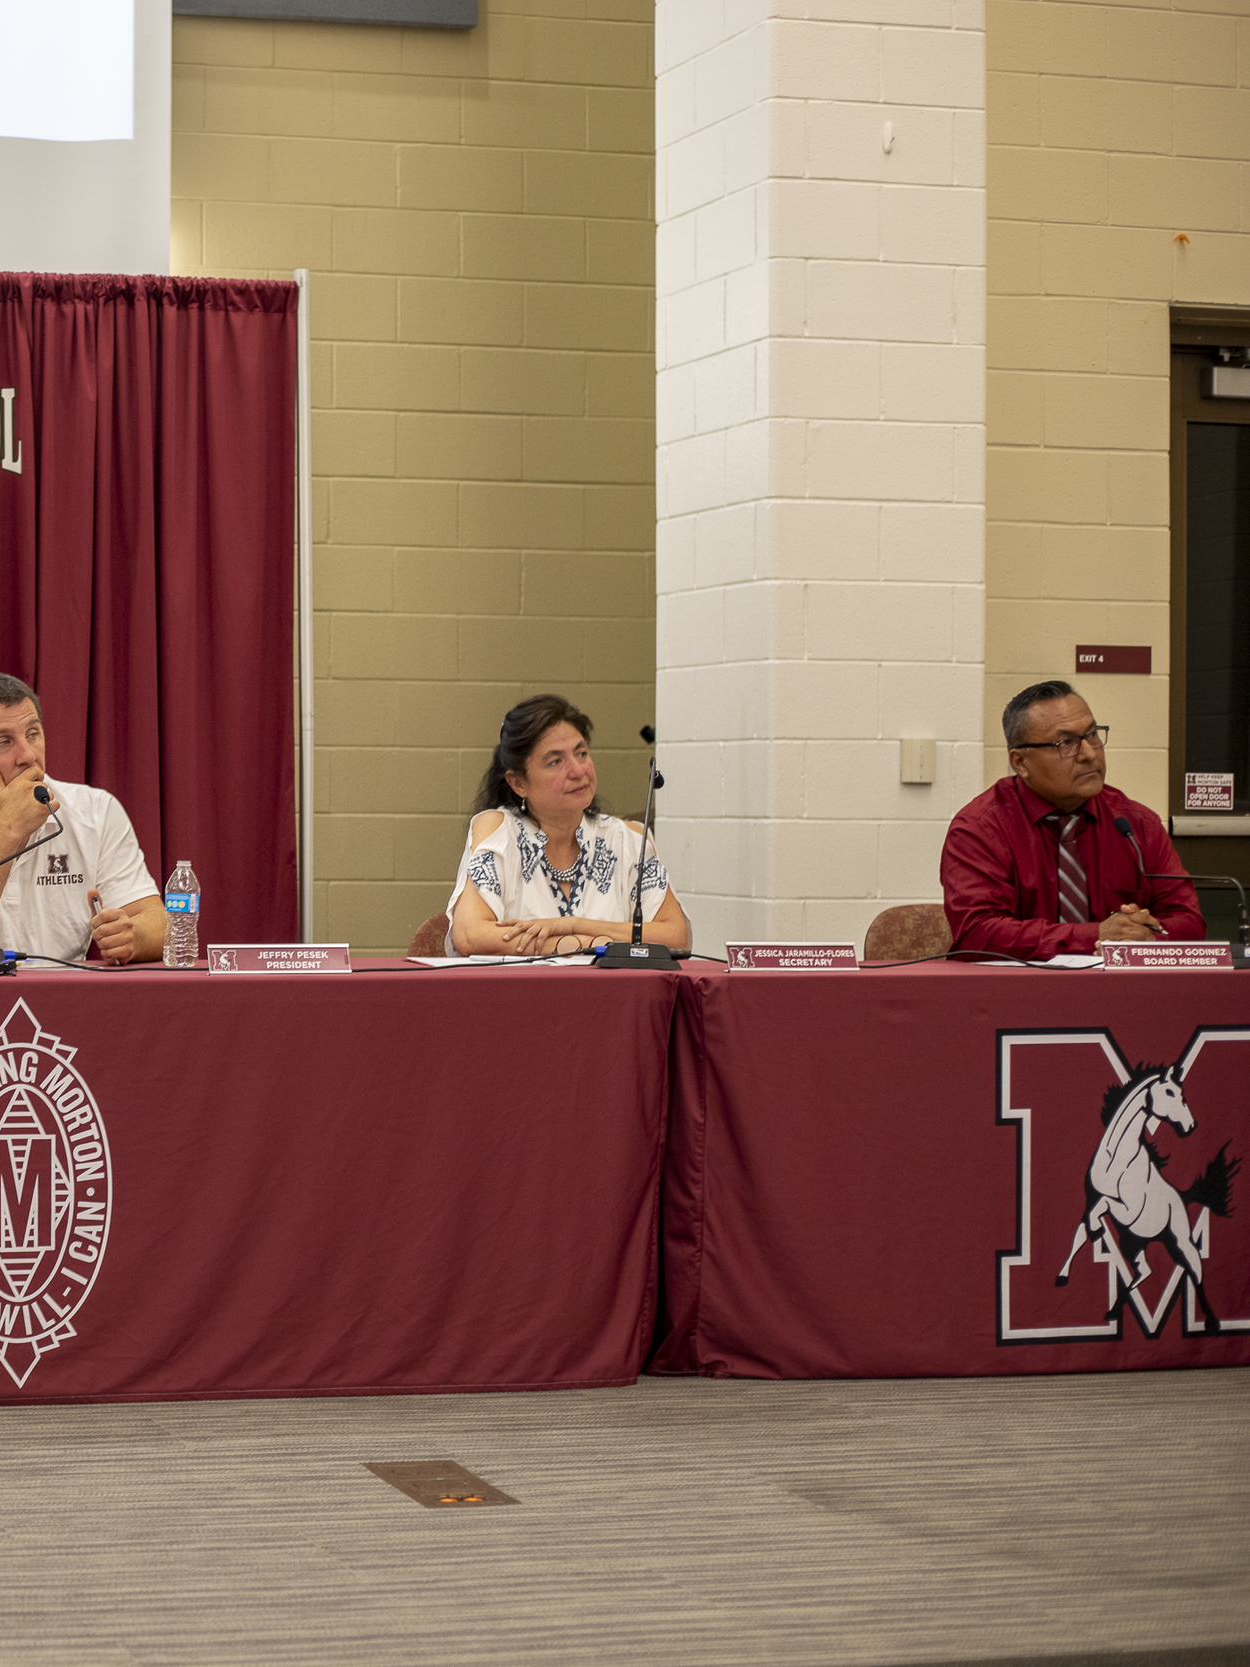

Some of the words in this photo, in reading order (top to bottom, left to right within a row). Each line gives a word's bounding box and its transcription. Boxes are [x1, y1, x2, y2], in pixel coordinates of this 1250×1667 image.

[1079, 654, 1097, 663] EXIT
[1098, 654, 1104, 663] 4
[1196, 786, 1207, 794] DO
[1208, 786, 1222, 794] NOT
[36, 874, 84, 886] ATHLETICS
[258, 951, 295, 960] JEFFRY
[297, 951, 329, 959] PESEK
[754, 950, 783, 958] JESSICA
[785, 950, 854, 958] JARAMILLO-FLORES
[1132, 948, 1182, 956] FERNANDO
[1185, 948, 1227, 956] GODINEZ
[266, 961, 322, 969] PRESIDENT
[779, 958, 833, 966] SECRETARY
[1179, 958, 1218, 966] MEMBER
[39, 1063, 105, 1182] MORTON
[68, 1201, 106, 1264] CAN
[60, 1267, 88, 1286] I
